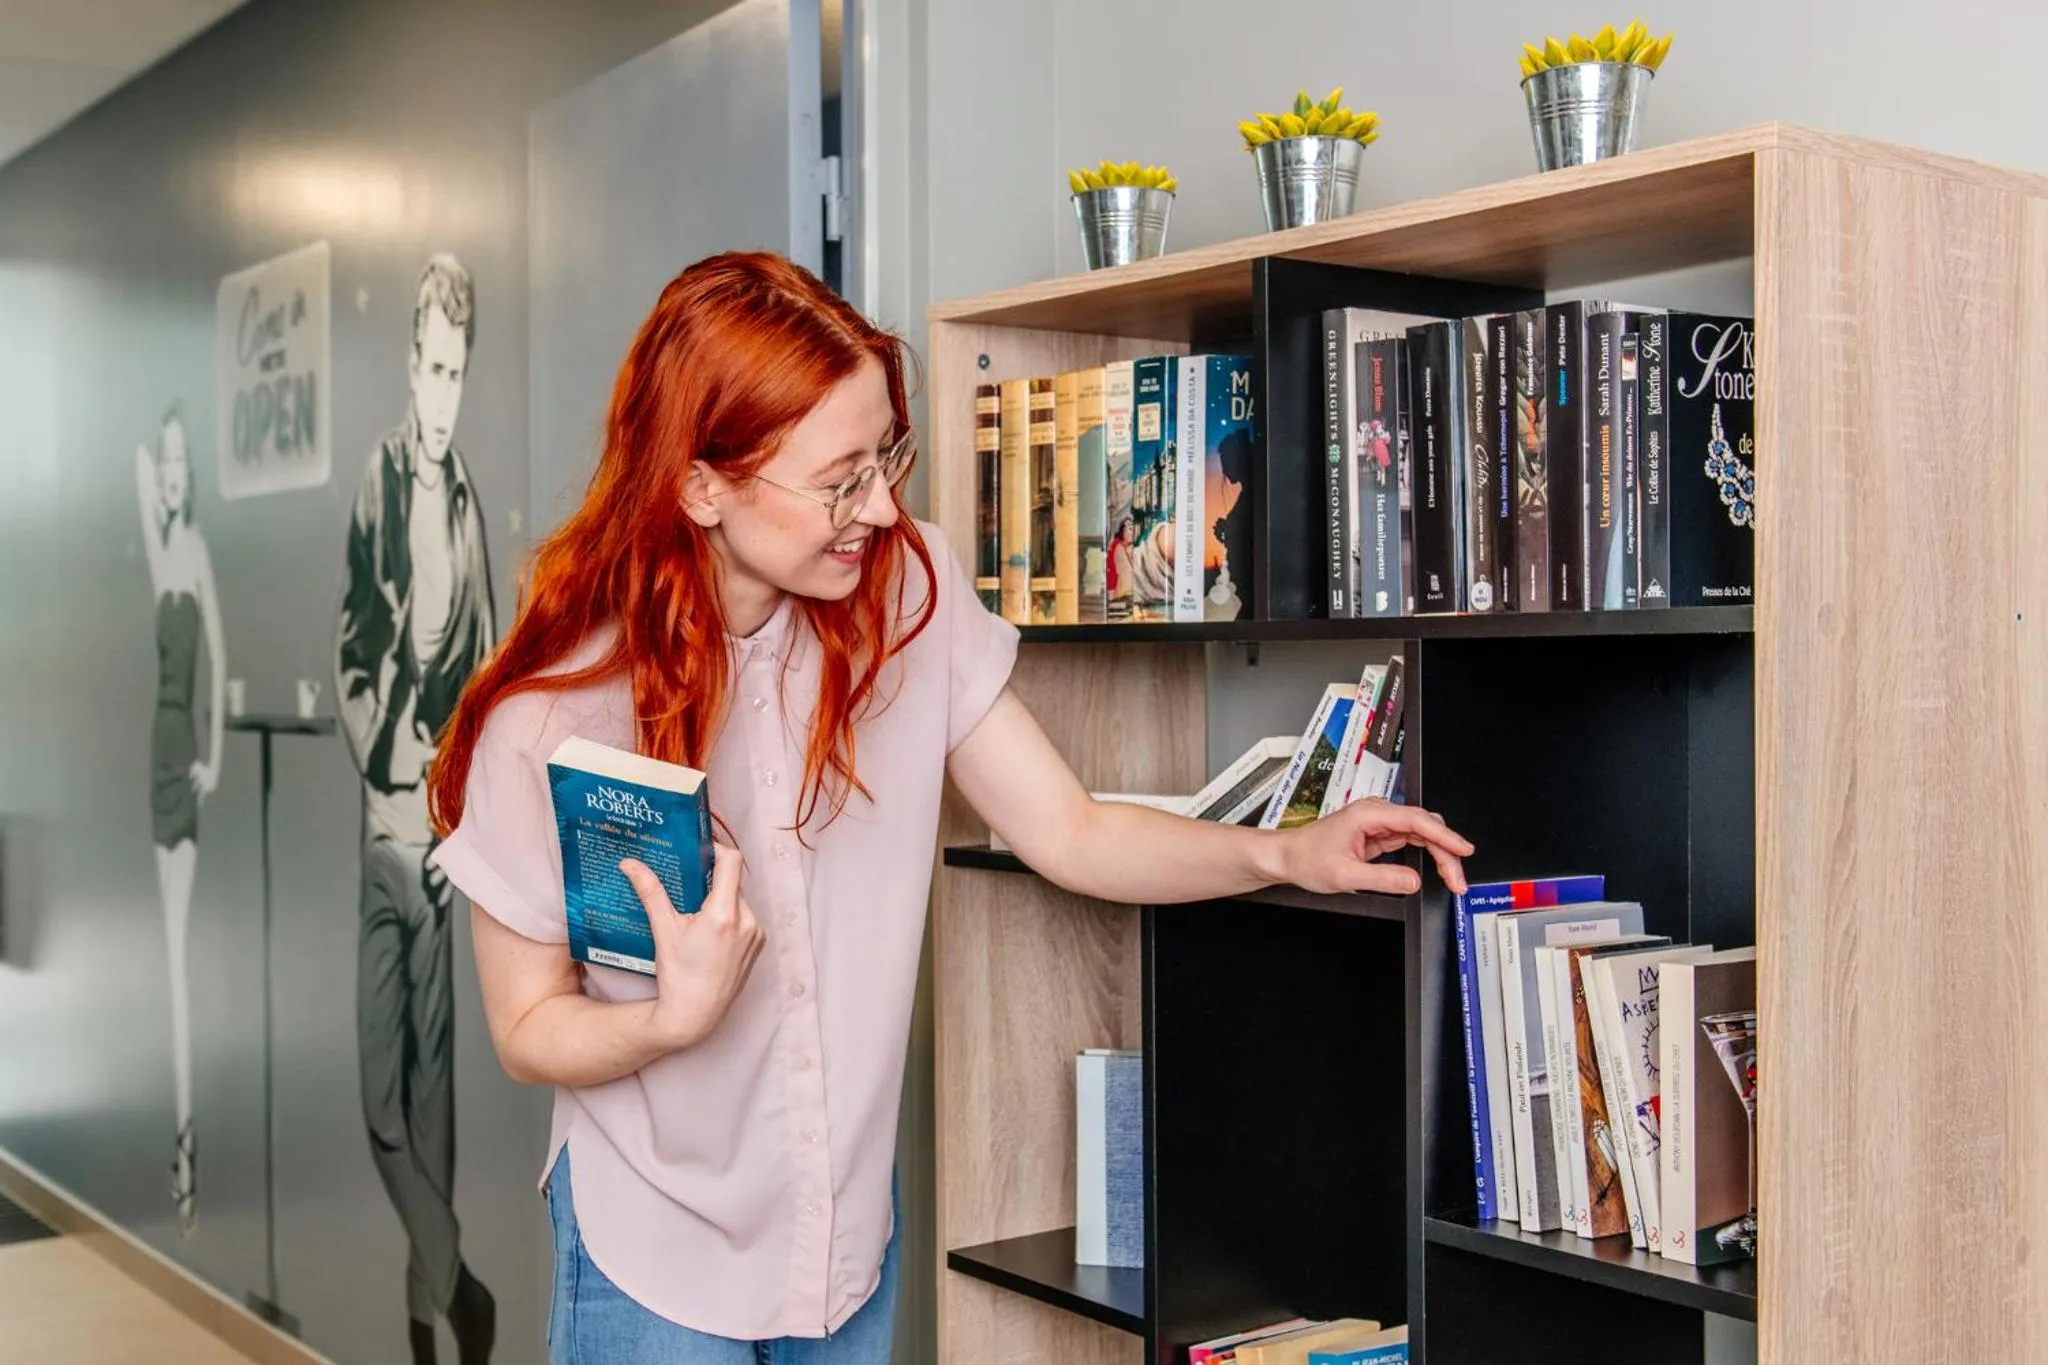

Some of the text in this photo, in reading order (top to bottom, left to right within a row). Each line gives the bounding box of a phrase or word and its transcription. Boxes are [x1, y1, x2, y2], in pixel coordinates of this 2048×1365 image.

[1498, 326, 1506, 358] Rezzori
[1557, 315, 1566, 344] Dexter
[1372, 356, 1384, 412] Jenna Blum
[1599, 333, 1610, 416] Sarah Dunant
[1642, 322, 1662, 415] Katherine Stone
[1188, 376, 1196, 406] COSTA
[1498, 378, 1508, 406] Gregor
[232, 370, 317, 468] OPEN
[1188, 408, 1196, 421] DA
[1498, 410, 1508, 455] Tchernopol
[1738, 432, 1753, 454] de
[1327, 329, 1342, 580] GREENLIGHTS McCONAUGHEY
[1648, 430, 1660, 504] Le Collier de Saphirs
[1500, 466, 1508, 500] hermine
[1600, 424, 1610, 528] Un cœur insoumis
[1500, 501, 1508, 518] Une
[1375, 494, 1387, 580] Het familieportret
[1702, 586, 1724, 598] Presses
[1724, 585, 1732, 596] de
[1732, 584, 1738, 596] la
[585, 792, 664, 825] ROBERTS
[598, 786, 649, 808] NORA
[580, 818, 592, 828] La
[625, 828, 637, 839] du
[1462, 974, 1472, 1012] États-Unis
[1466, 1029, 1476, 1069] présidence
[1513, 1041, 1524, 1080] Finlande
[1518, 1095, 1528, 1113] Paul
[1473, 1132, 1482, 1164] L'empire
